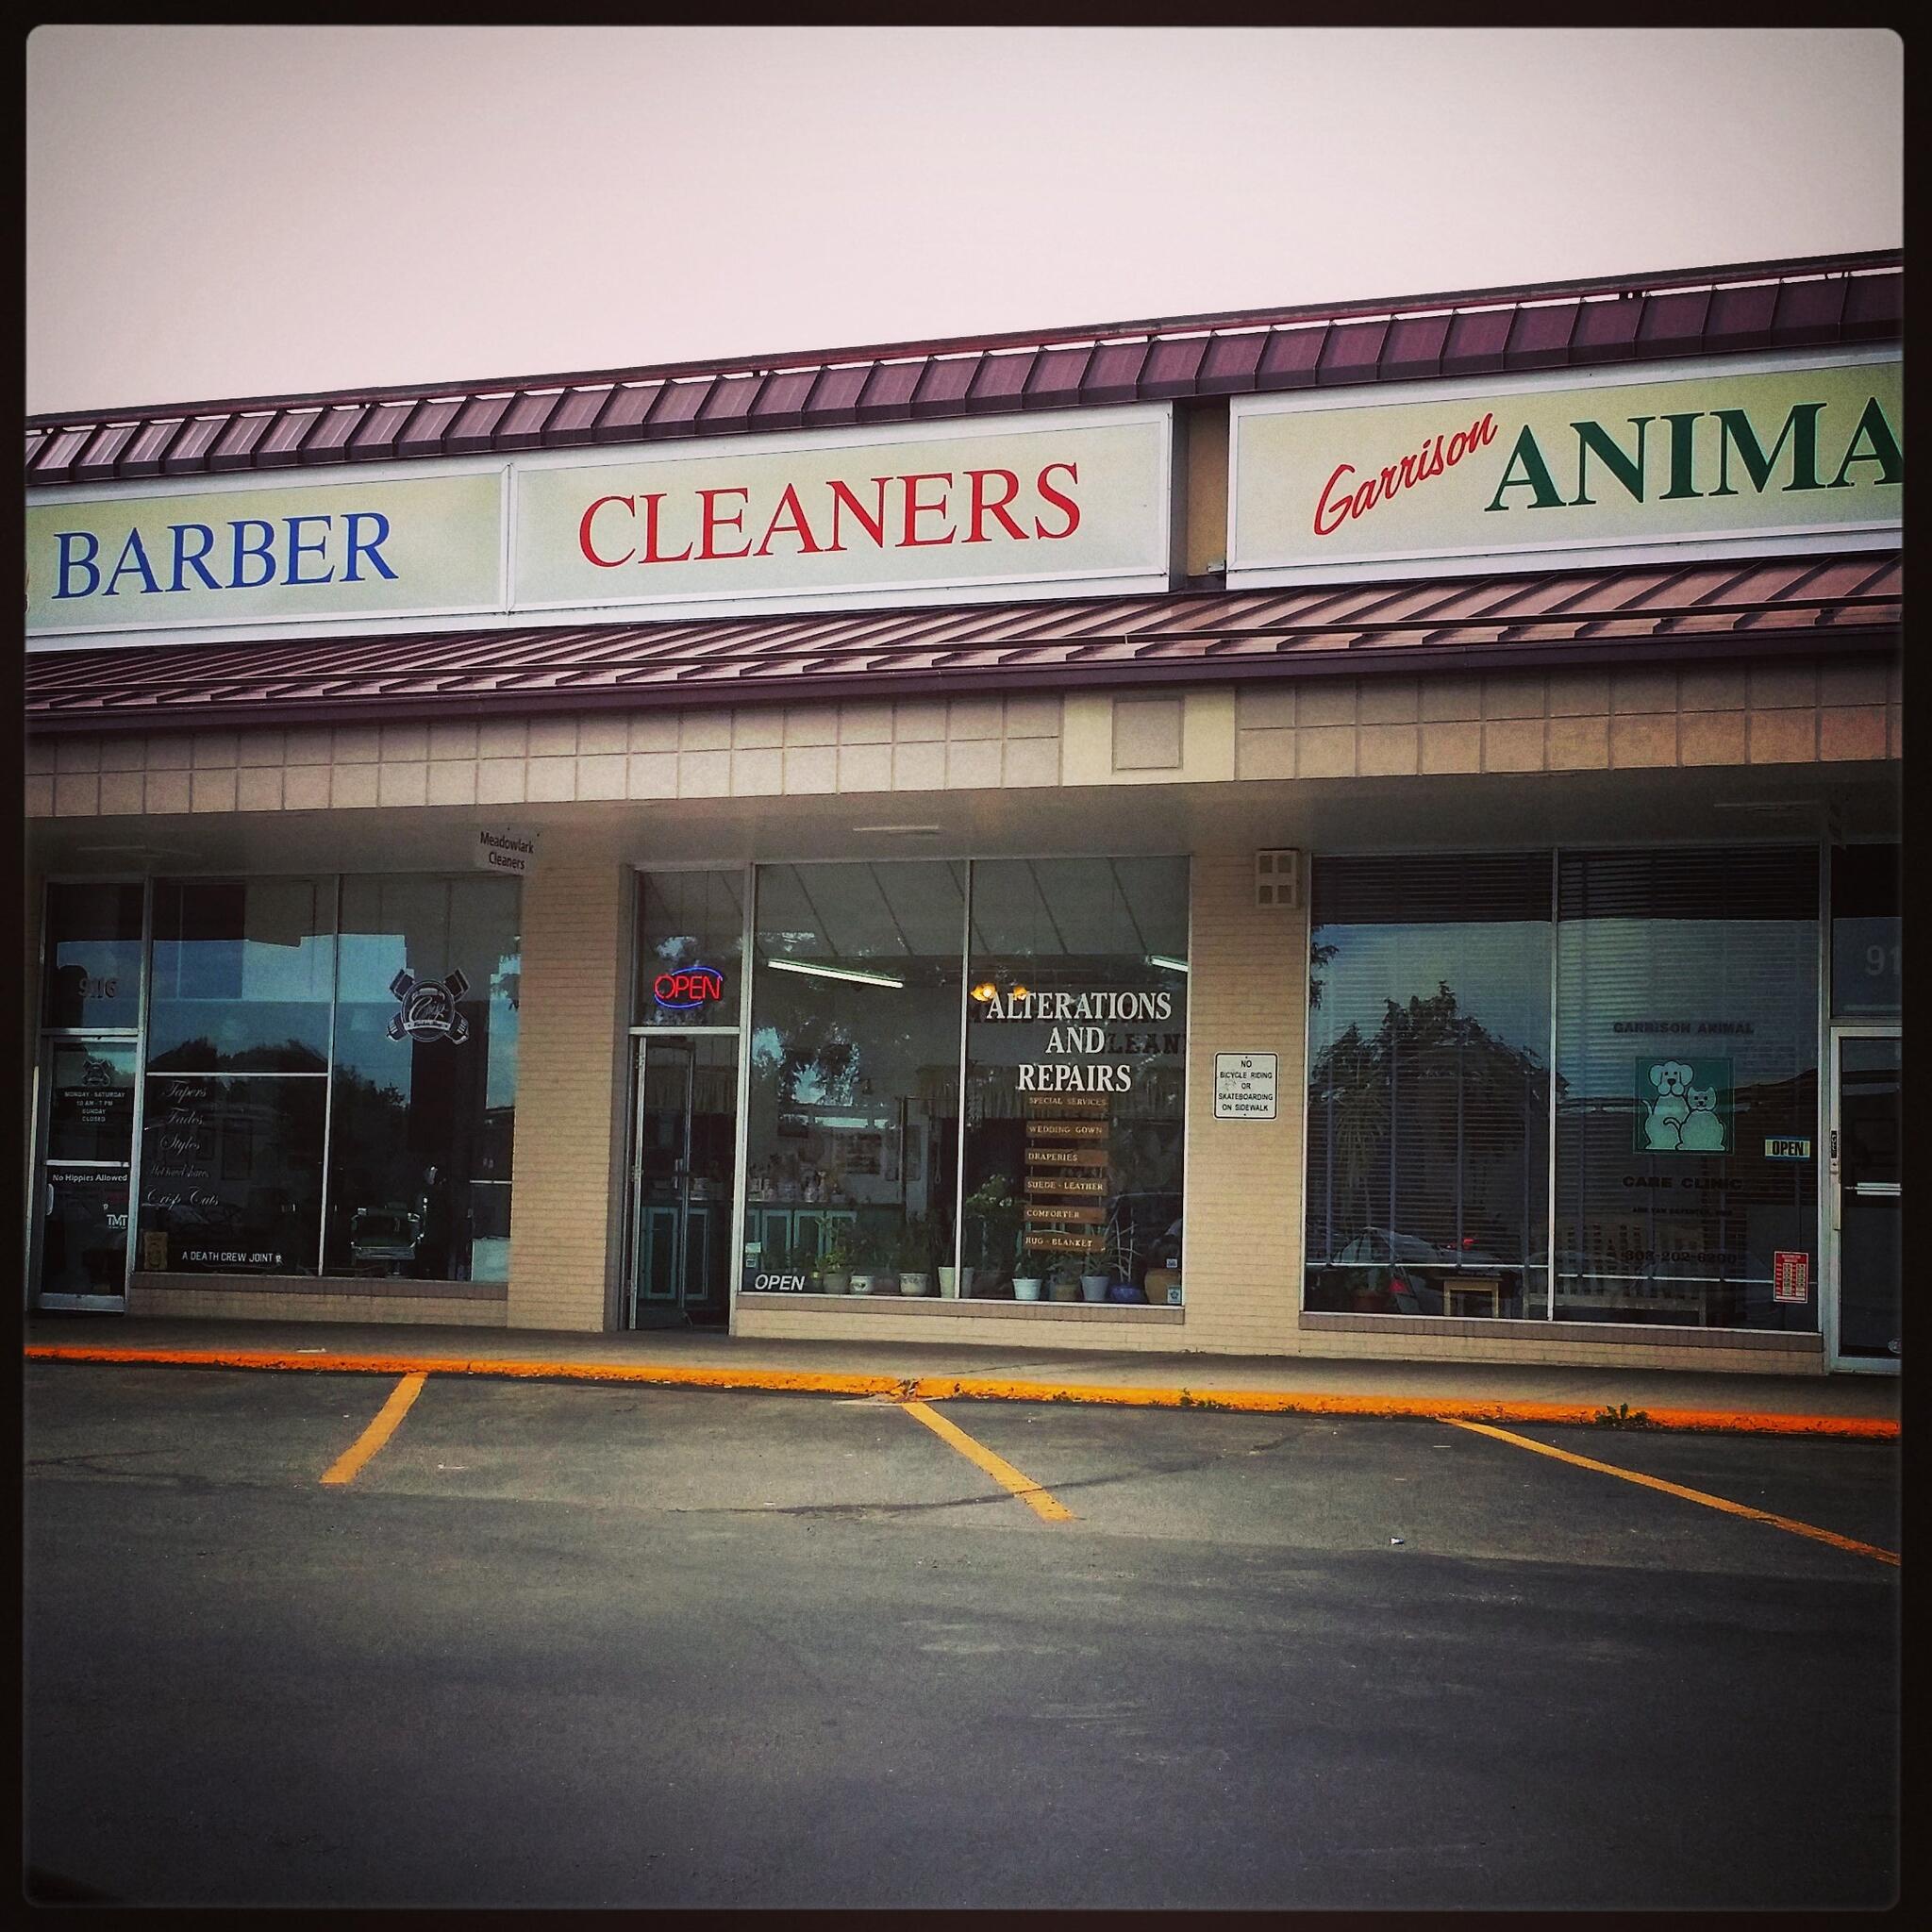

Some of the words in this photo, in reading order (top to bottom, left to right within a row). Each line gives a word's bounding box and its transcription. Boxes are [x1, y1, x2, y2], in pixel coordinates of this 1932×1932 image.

[1484, 396, 1903, 512] ANIMA
[1314, 411, 1498, 536] Garrison
[579, 461, 1081, 568] CLEANERS
[51, 512, 400, 600] BARBER
[480, 831, 534, 854] Meadowlark
[489, 851, 525, 870] Cleaners
[78, 977, 118, 998] 916
[653, 974, 722, 1001] OPEN
[986, 991, 1173, 1021] ALTERATIONS
[1613, 1021, 1692, 1034] GARRISON
[1697, 1022, 1755, 1035] ANIMAL
[1044, 1025, 1107, 1055] AND
[1241, 1059, 1253, 1068] NO
[1016, 1063, 1133, 1093] REPAIRS
[1220, 1071, 1247, 1079] BICYCLE
[162, 1079, 208, 1104] Tapers
[1218, 1092, 1274, 1101] SKATEBOARDING
[1029, 1096, 1063, 1106] SPECIAL
[1066, 1097, 1108, 1108] SERVICES
[1222, 1103, 1232, 1111] ON
[1235, 1104, 1269, 1112] SIDEWALK
[165, 1107, 205, 1125] Fades
[1028, 1124, 1071, 1134] WEDDING
[1074, 1125, 1103, 1135] GOWN
[159, 1133, 201, 1155] Styles
[1772, 1140, 1805, 1158] OPEN
[1027, 1152, 1079, 1162] DRAPERIES
[65, 1174, 94, 1183] Hippies
[95, 1174, 128, 1182] Allowed
[1026, 1180, 1057, 1190] SUEDE
[1063, 1181, 1104, 1191] LEATHER
[1622, 1175, 1674, 1189] CARE
[1680, 1177, 1743, 1190] CLINIC
[107, 1213, 128, 1226] TMT
[1026, 1208, 1080, 1219] COMFORTER
[1025, 1236, 1044, 1245] RUG
[1051, 1238, 1093, 1247] BLANKET
[181, 1251, 190, 1261] A
[190, 1251, 220, 1262] DEATH
[220, 1252, 246, 1263] CREW
[248, 1253, 274, 1264] JOINT
[755, 1274, 806, 1291] OPEN
